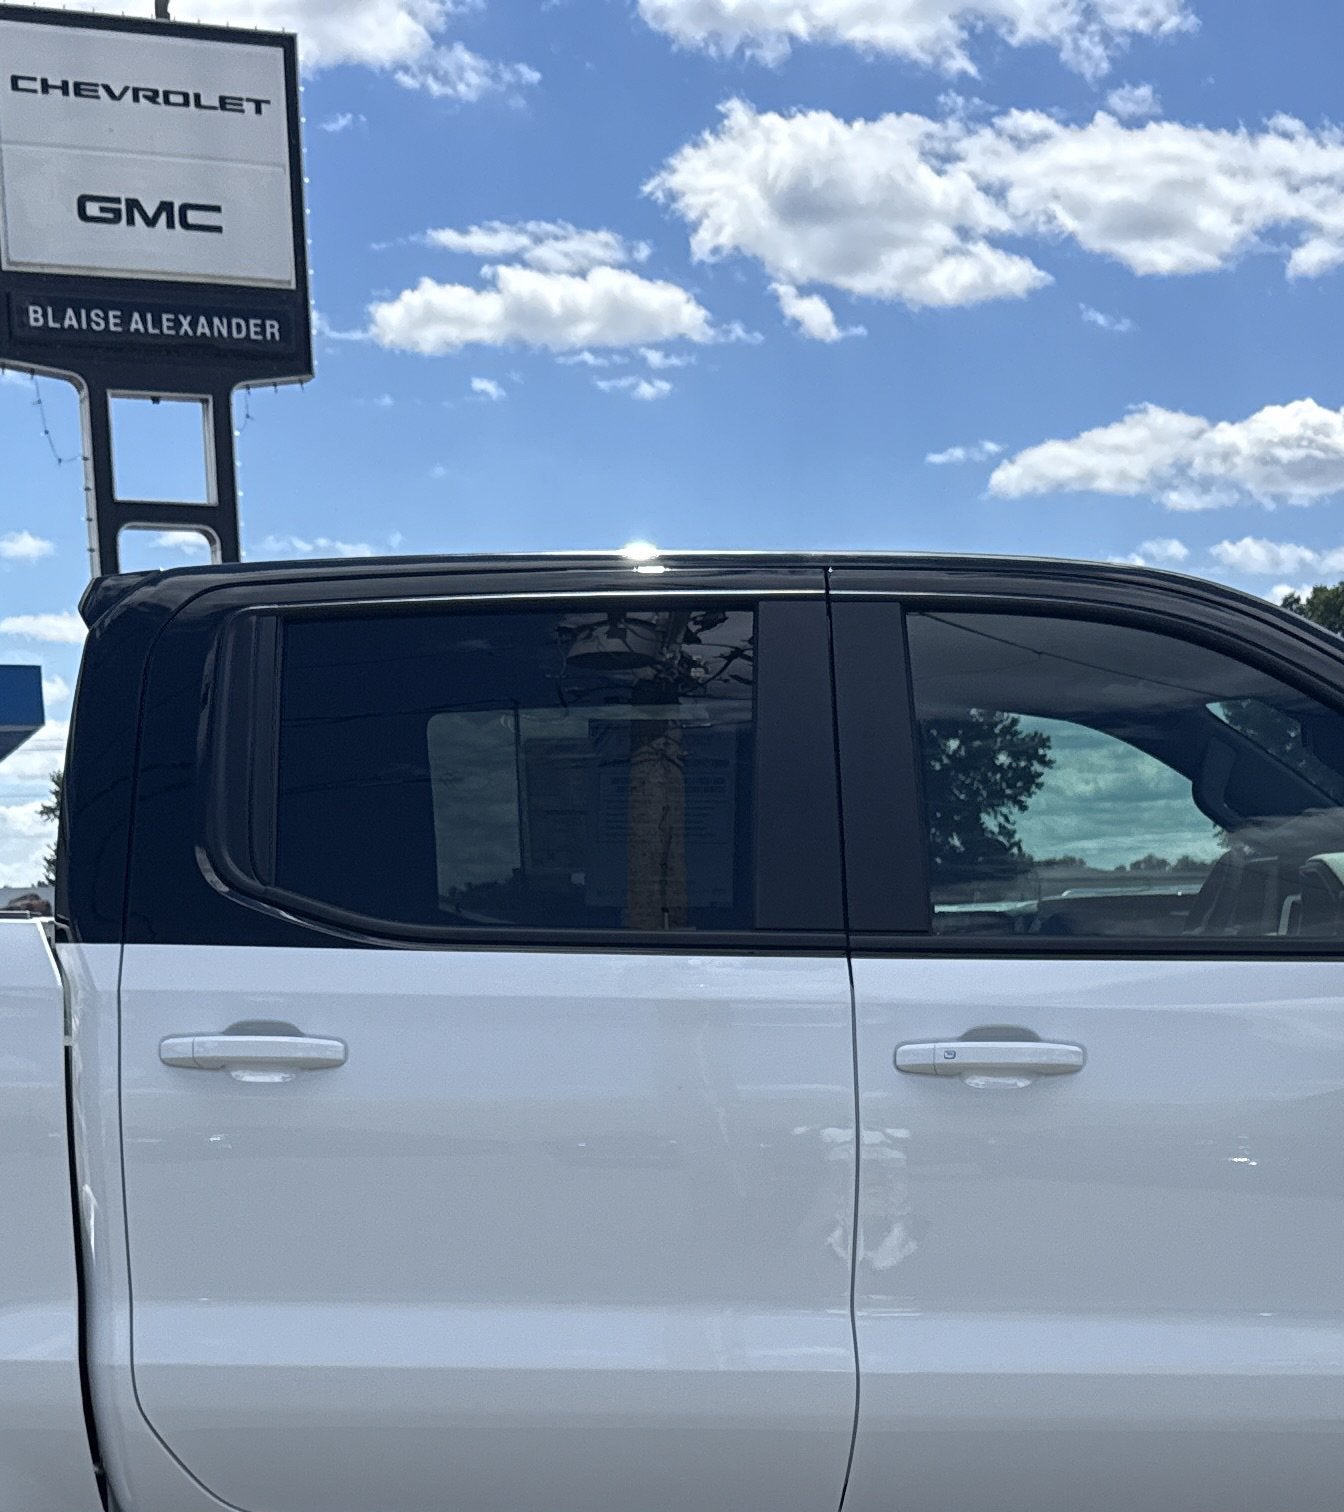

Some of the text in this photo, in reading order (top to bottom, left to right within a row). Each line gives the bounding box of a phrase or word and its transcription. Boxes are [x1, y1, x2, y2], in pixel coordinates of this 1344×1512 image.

[9, 74, 272, 116] CHEVROLET
[76, 193, 224, 235] GMC
[27, 303, 282, 342] BLAISE ALEXANDER
